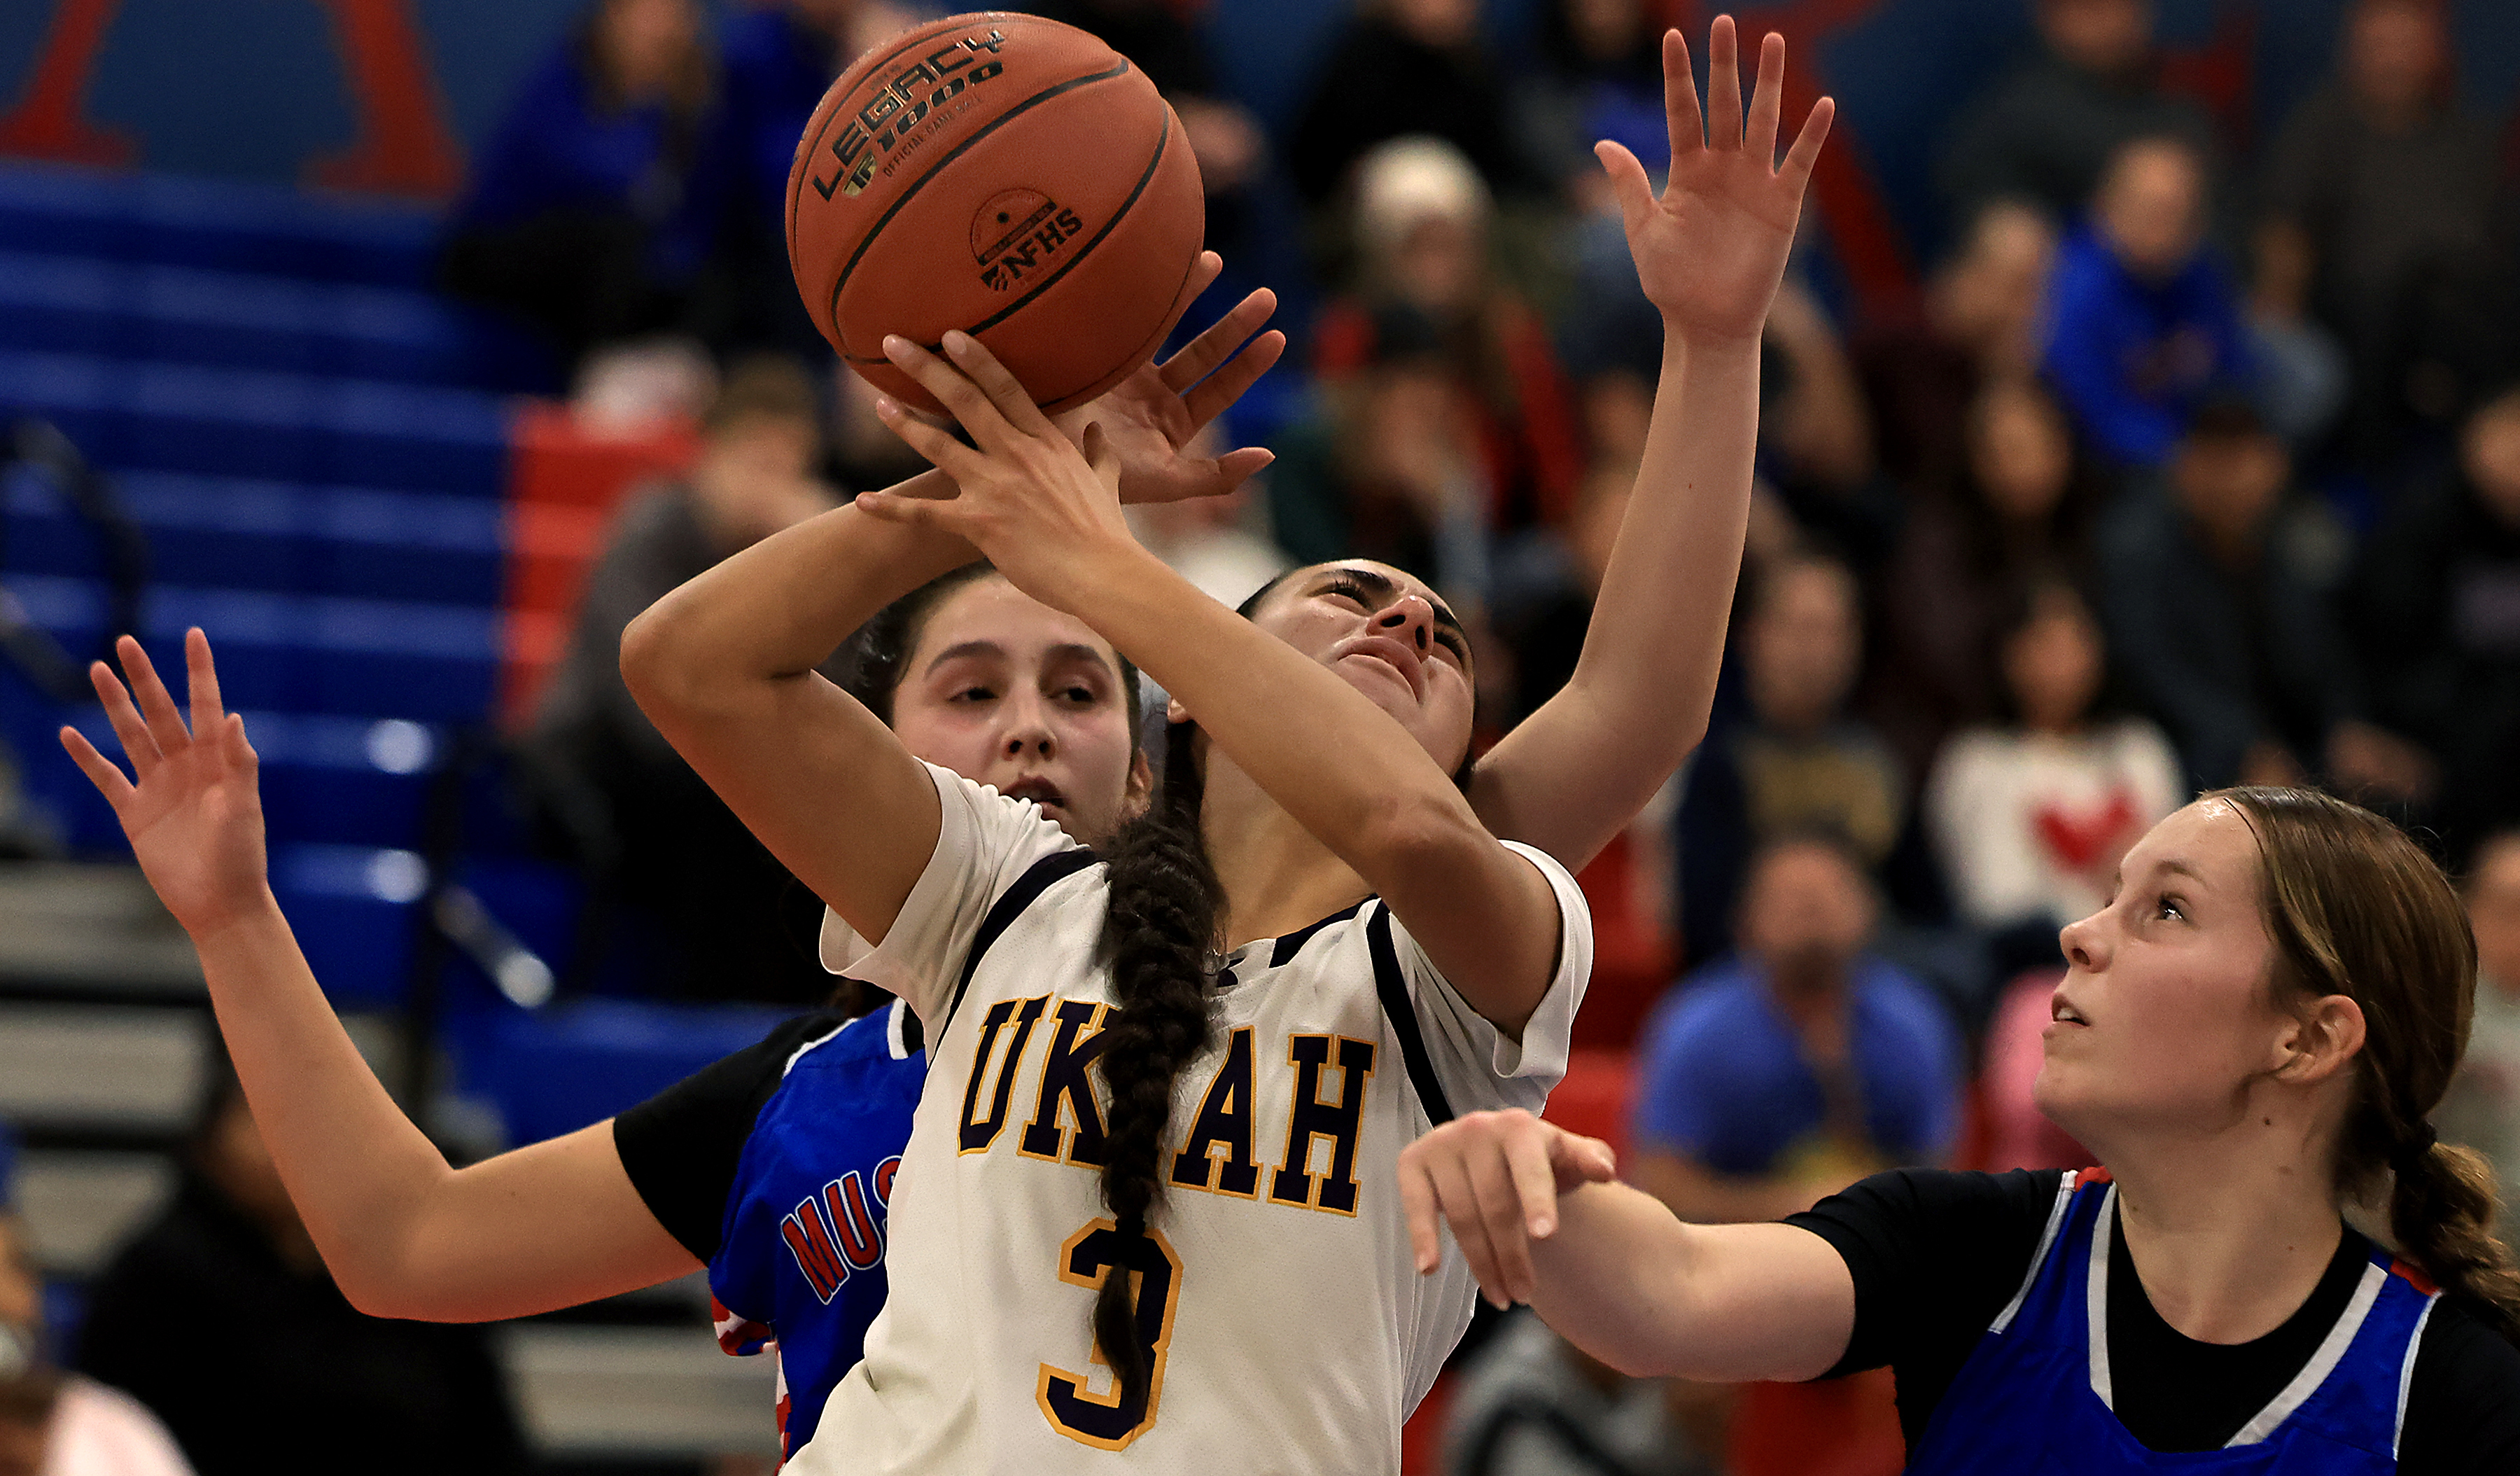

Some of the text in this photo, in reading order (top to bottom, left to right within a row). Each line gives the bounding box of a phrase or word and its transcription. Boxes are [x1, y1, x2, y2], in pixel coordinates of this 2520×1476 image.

[812, 30, 1004, 202] LEGACY
[843, 61, 1003, 195] TF 1000
[883, 134, 924, 177] OFFICIAL
[1001, 207, 1083, 280] NFHS
[957, 991, 1378, 1218] UKAH
[1035, 1216, 1184, 1451] 3
